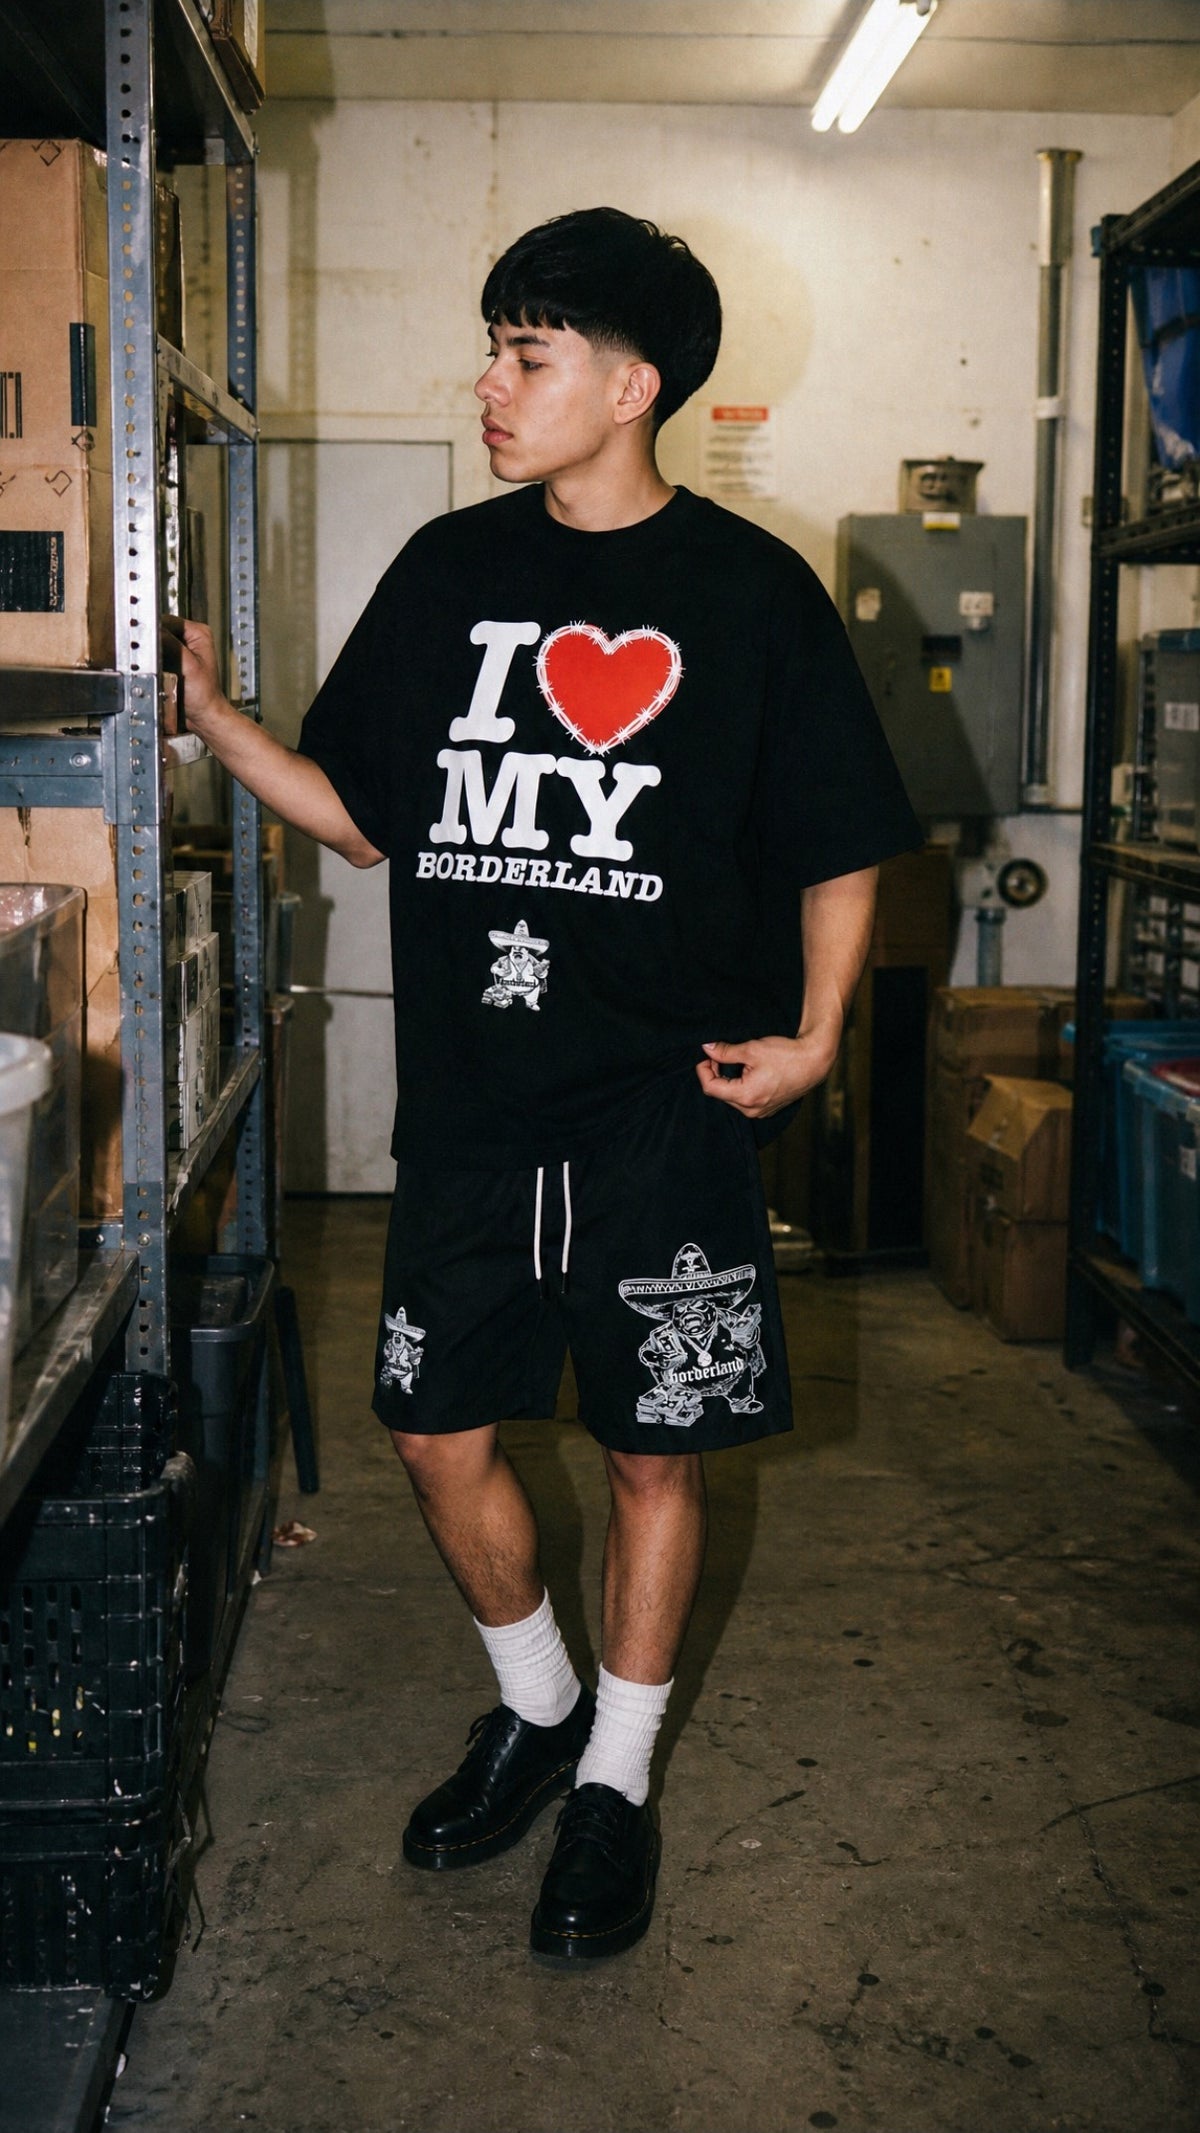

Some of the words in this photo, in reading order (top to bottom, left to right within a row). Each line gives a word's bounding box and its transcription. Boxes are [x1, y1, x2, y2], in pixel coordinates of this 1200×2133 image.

[449, 620, 542, 744] I
[428, 749, 662, 862] MY
[416, 851, 664, 902] BORDERLAND
[670, 1356, 744, 1383] borderland
